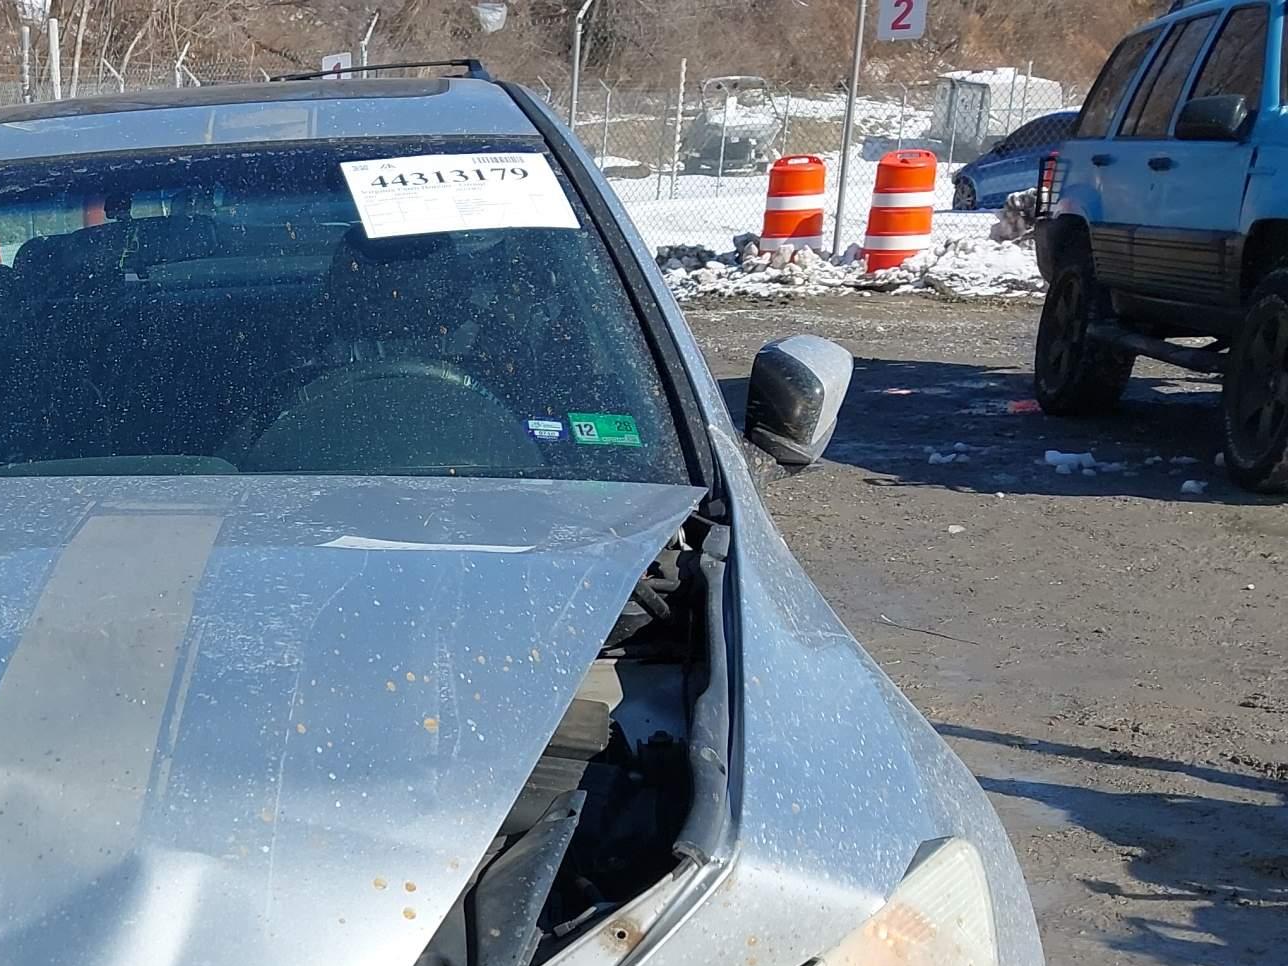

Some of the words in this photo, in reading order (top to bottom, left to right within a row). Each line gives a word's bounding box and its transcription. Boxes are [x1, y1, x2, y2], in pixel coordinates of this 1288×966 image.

[891, 0, 913, 30] 2
[370, 167, 529, 188] 44313179
[575, 423, 596, 437] 12
